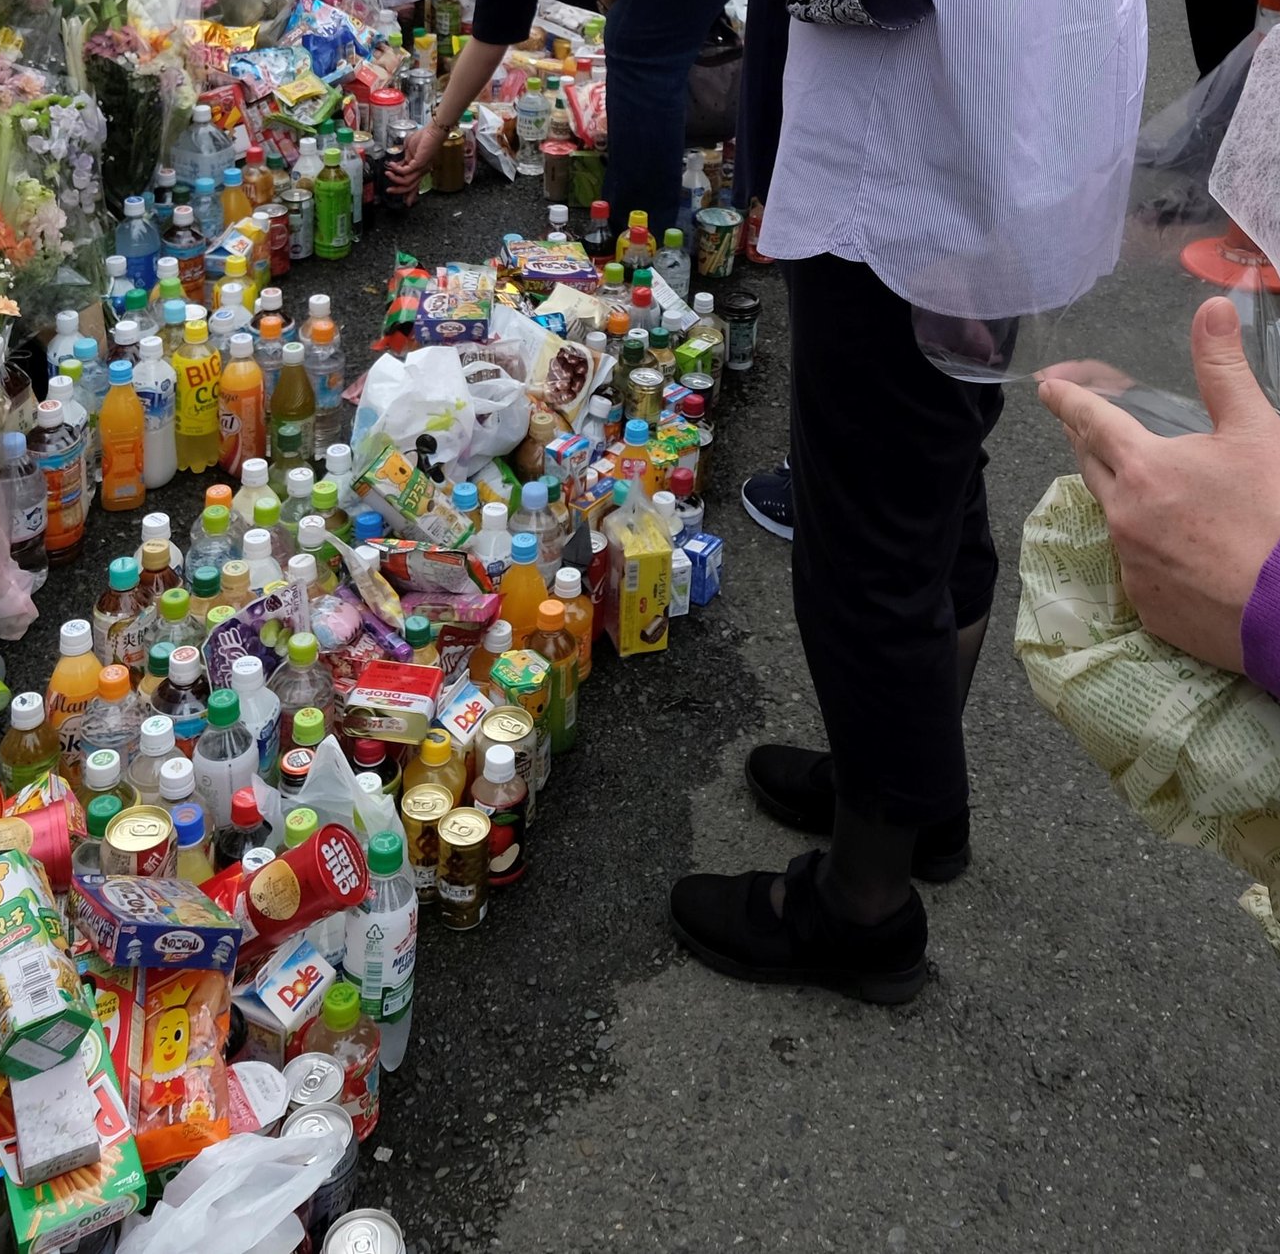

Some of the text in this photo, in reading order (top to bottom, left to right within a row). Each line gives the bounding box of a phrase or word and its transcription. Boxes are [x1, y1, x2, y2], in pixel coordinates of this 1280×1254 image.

[356, 688, 402, 700] DROPS
[453, 699, 484, 731] Dole
[321, 843, 351, 895] chip
[330, 836, 360, 888] star
[160, 935, 200, 951] きのこの山
[277, 965, 321, 1008] Dole
